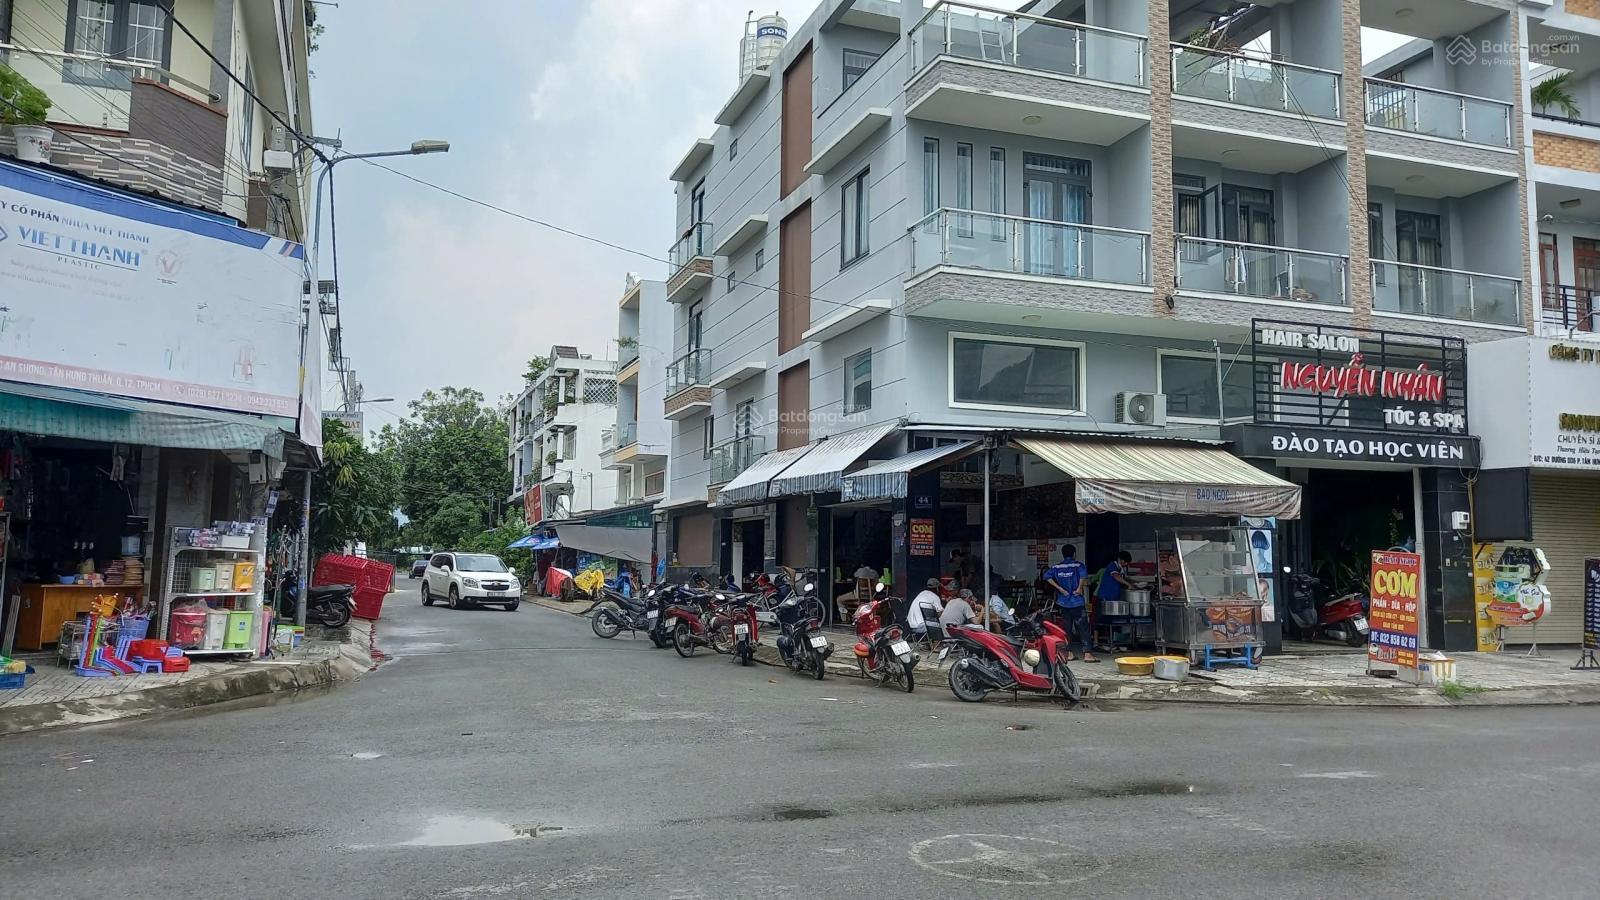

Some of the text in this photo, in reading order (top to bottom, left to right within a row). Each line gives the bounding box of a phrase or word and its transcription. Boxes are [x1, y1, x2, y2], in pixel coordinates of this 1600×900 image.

[1261, 328, 1360, 353] HAIR SALON
[1384, 406, 1465, 429] TÓC & SPA
[1271, 432, 1464, 461] ĐÀO TẠO HỌC VIÊN
[918, 496, 929, 504] 44
[1374, 569, 1418, 599] CƠM
